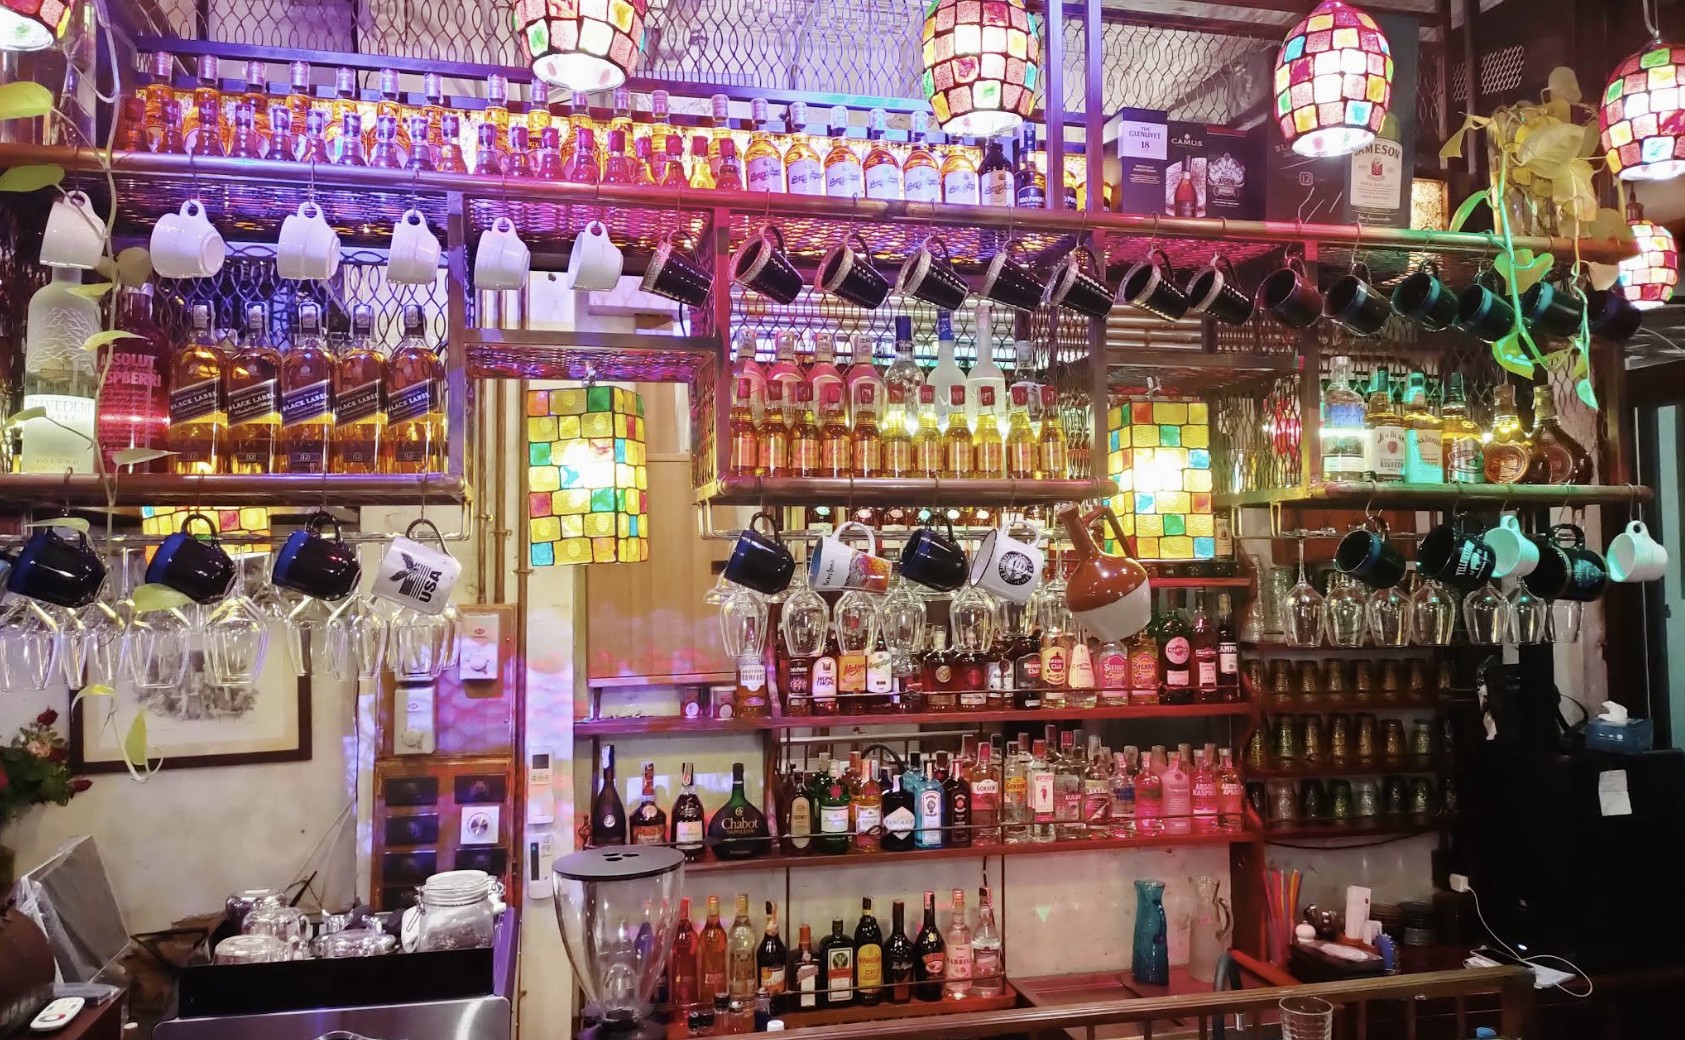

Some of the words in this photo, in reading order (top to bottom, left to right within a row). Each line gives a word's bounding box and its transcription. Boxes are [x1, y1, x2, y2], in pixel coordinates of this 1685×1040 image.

[1128, 130, 1161, 140] GLENLIVET
[1171, 138, 1203, 147] CAMUS
[1141, 141, 1150, 149] 18
[1301, 174, 1311, 183] 12
[101, 352, 156, 368] ASOLUT
[104, 371, 162, 387] SPBERRI
[170, 398, 192, 411] BLACK
[193, 391, 218, 402] LABEL
[228, 399, 252, 411] BLACK
[252, 392, 277, 403] LABEL
[282, 400, 305, 412] BLACK
[305, 392, 330, 404] LABEL
[335, 400, 357, 412] BLACK
[357, 392, 380, 404] LABEL
[388, 400, 409, 412] BLACK
[408, 391, 431, 404] LABEL
[419, 571, 442, 603] USA
[721, 817, 760, 830] Chabot
